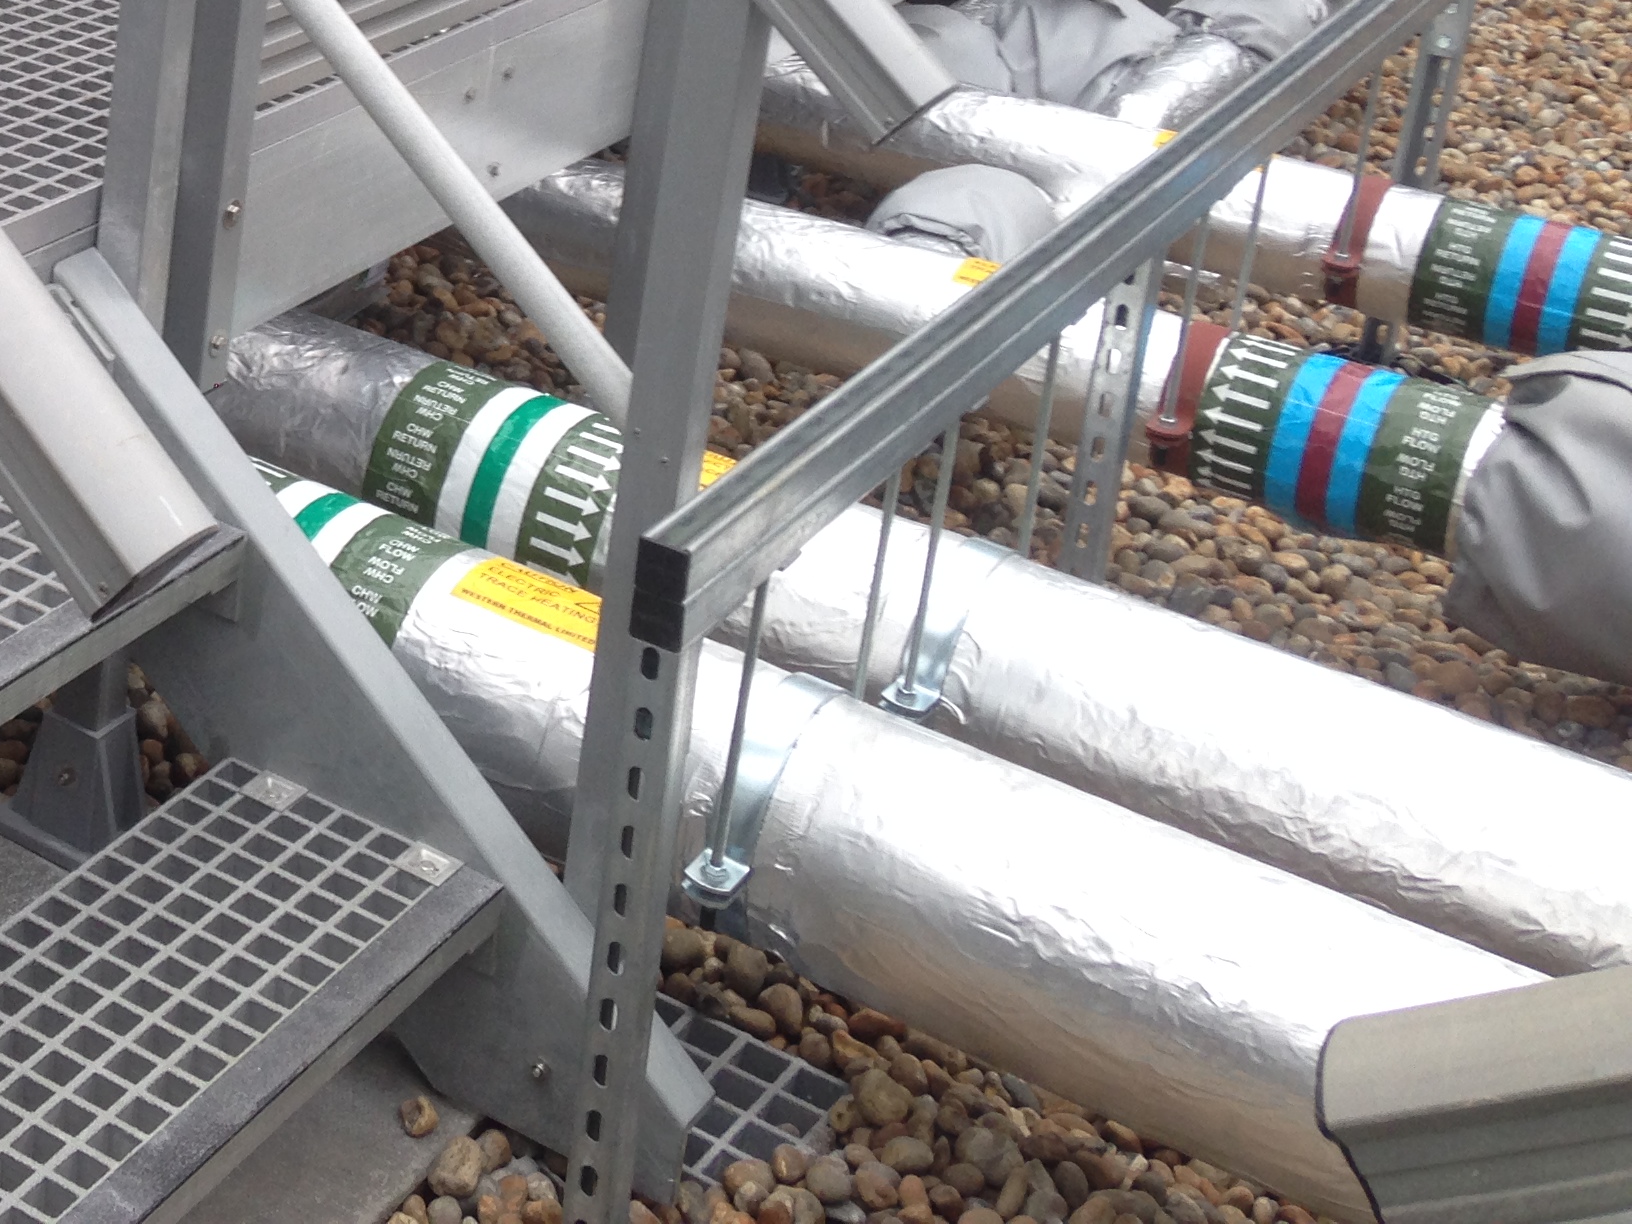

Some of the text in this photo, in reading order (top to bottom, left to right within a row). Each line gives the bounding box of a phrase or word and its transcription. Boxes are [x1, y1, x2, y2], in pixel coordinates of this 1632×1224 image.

[421, 384, 468, 405] RETURN
[436, 380, 465, 395] CHW
[412, 394, 458, 417] RETURN
[415, 406, 445, 422] CHW
[405, 422, 434, 439] CHW
[1411, 427, 1441, 443] HTG
[391, 430, 439, 455] RETURN
[1401, 435, 1442, 455] FLOW
[386, 446, 433, 473] RETURN
[1395, 453, 1437, 473] FLOW
[391, 462, 419, 480] CHW
[1398, 465, 1428, 482] HTG
[385, 481, 414, 499] CHW
[1392, 485, 1422, 501] HTG
[375, 488, 419, 514] RETURN
[1385, 493, 1425, 512] FLOW
[378, 543, 417, 563] FLOW
[388, 539, 421, 554] CHW
[362, 566, 395, 585] CHW
[367, 555, 406, 576] FLOW
[488, 565, 562, 598] ELECTRIC
[351, 584, 384, 604] CHW
[479, 572, 599, 625] TRACE HEATING
[461, 587, 596, 646] WESTERN THERMAL LIMITED
